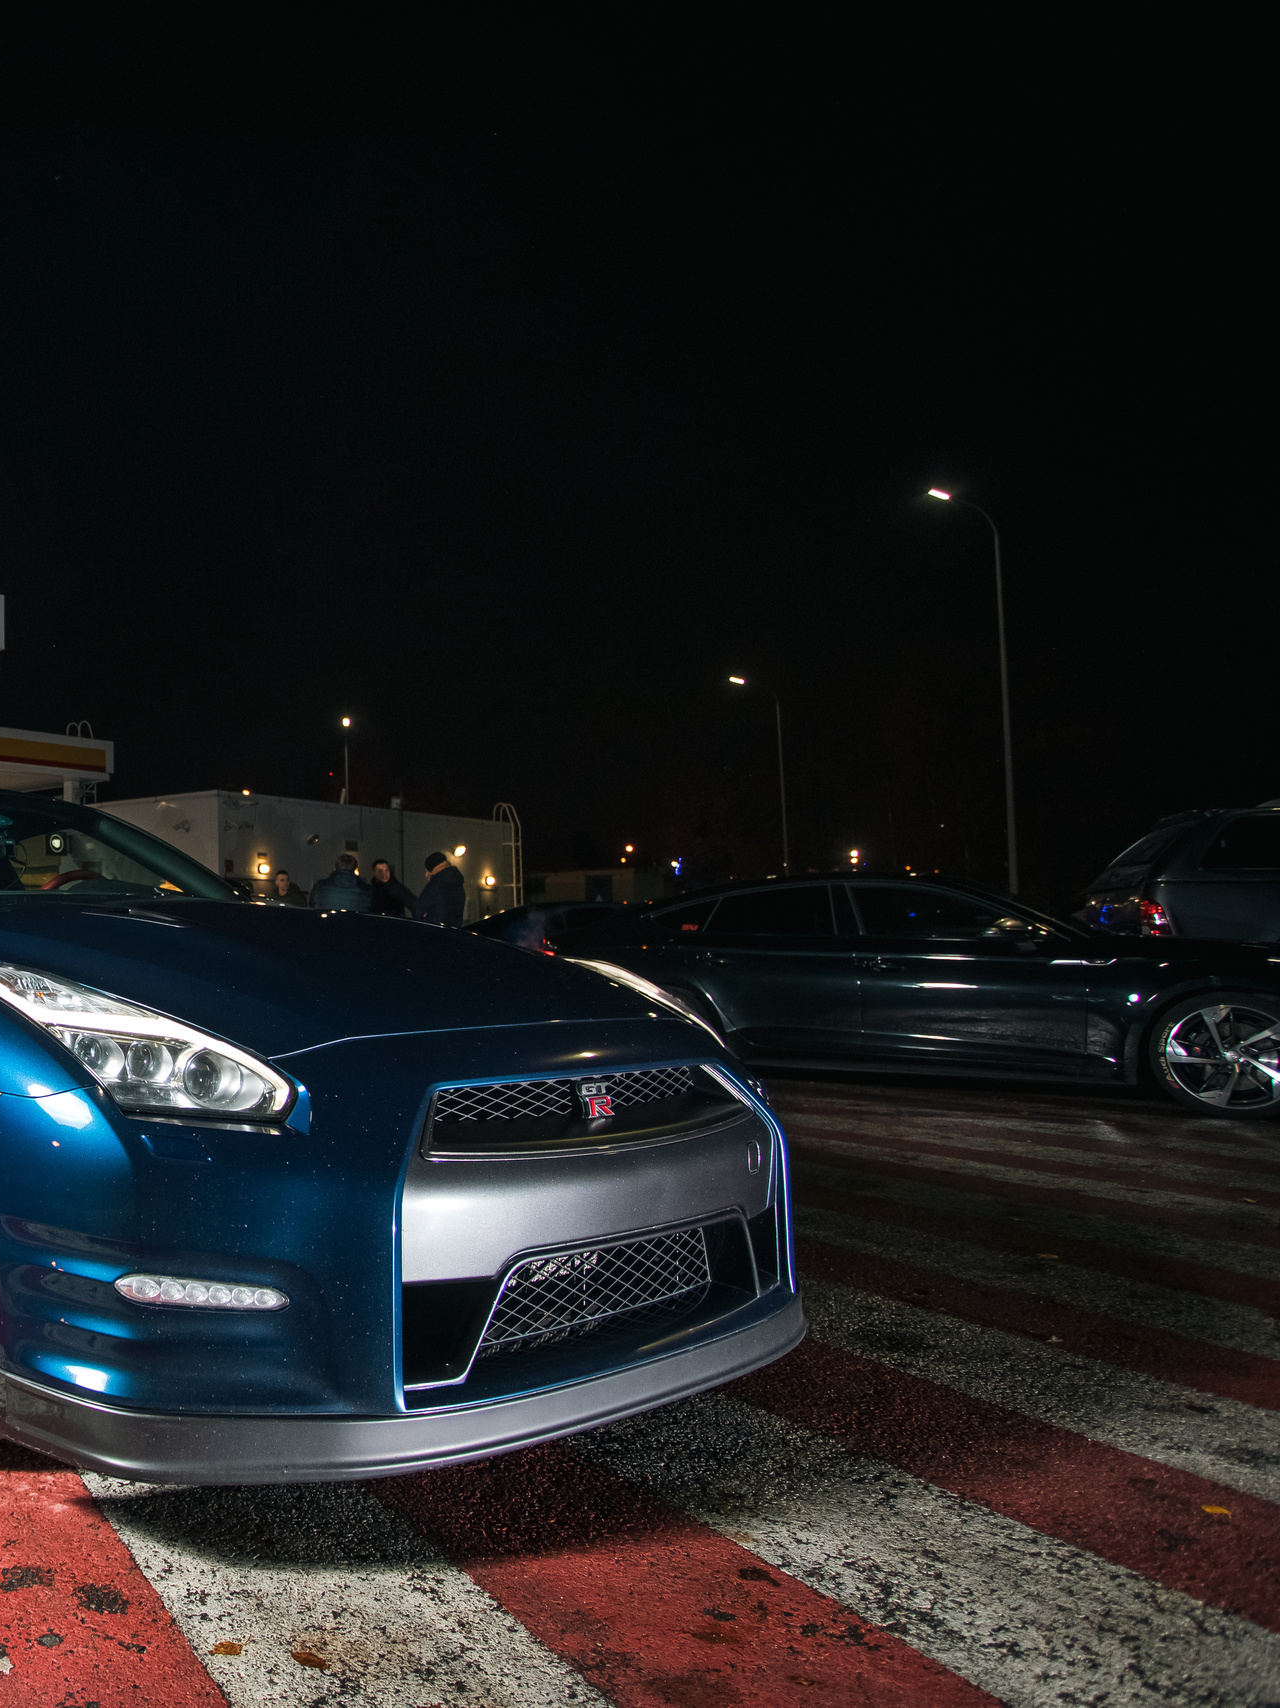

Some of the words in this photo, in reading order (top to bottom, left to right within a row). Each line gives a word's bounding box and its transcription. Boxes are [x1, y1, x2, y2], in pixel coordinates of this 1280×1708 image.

[1158, 1022, 1175, 1053] Sport
[1159, 1056, 1175, 1081] Audi
[581, 1081, 609, 1096] GT
[586, 1095, 616, 1118] R
